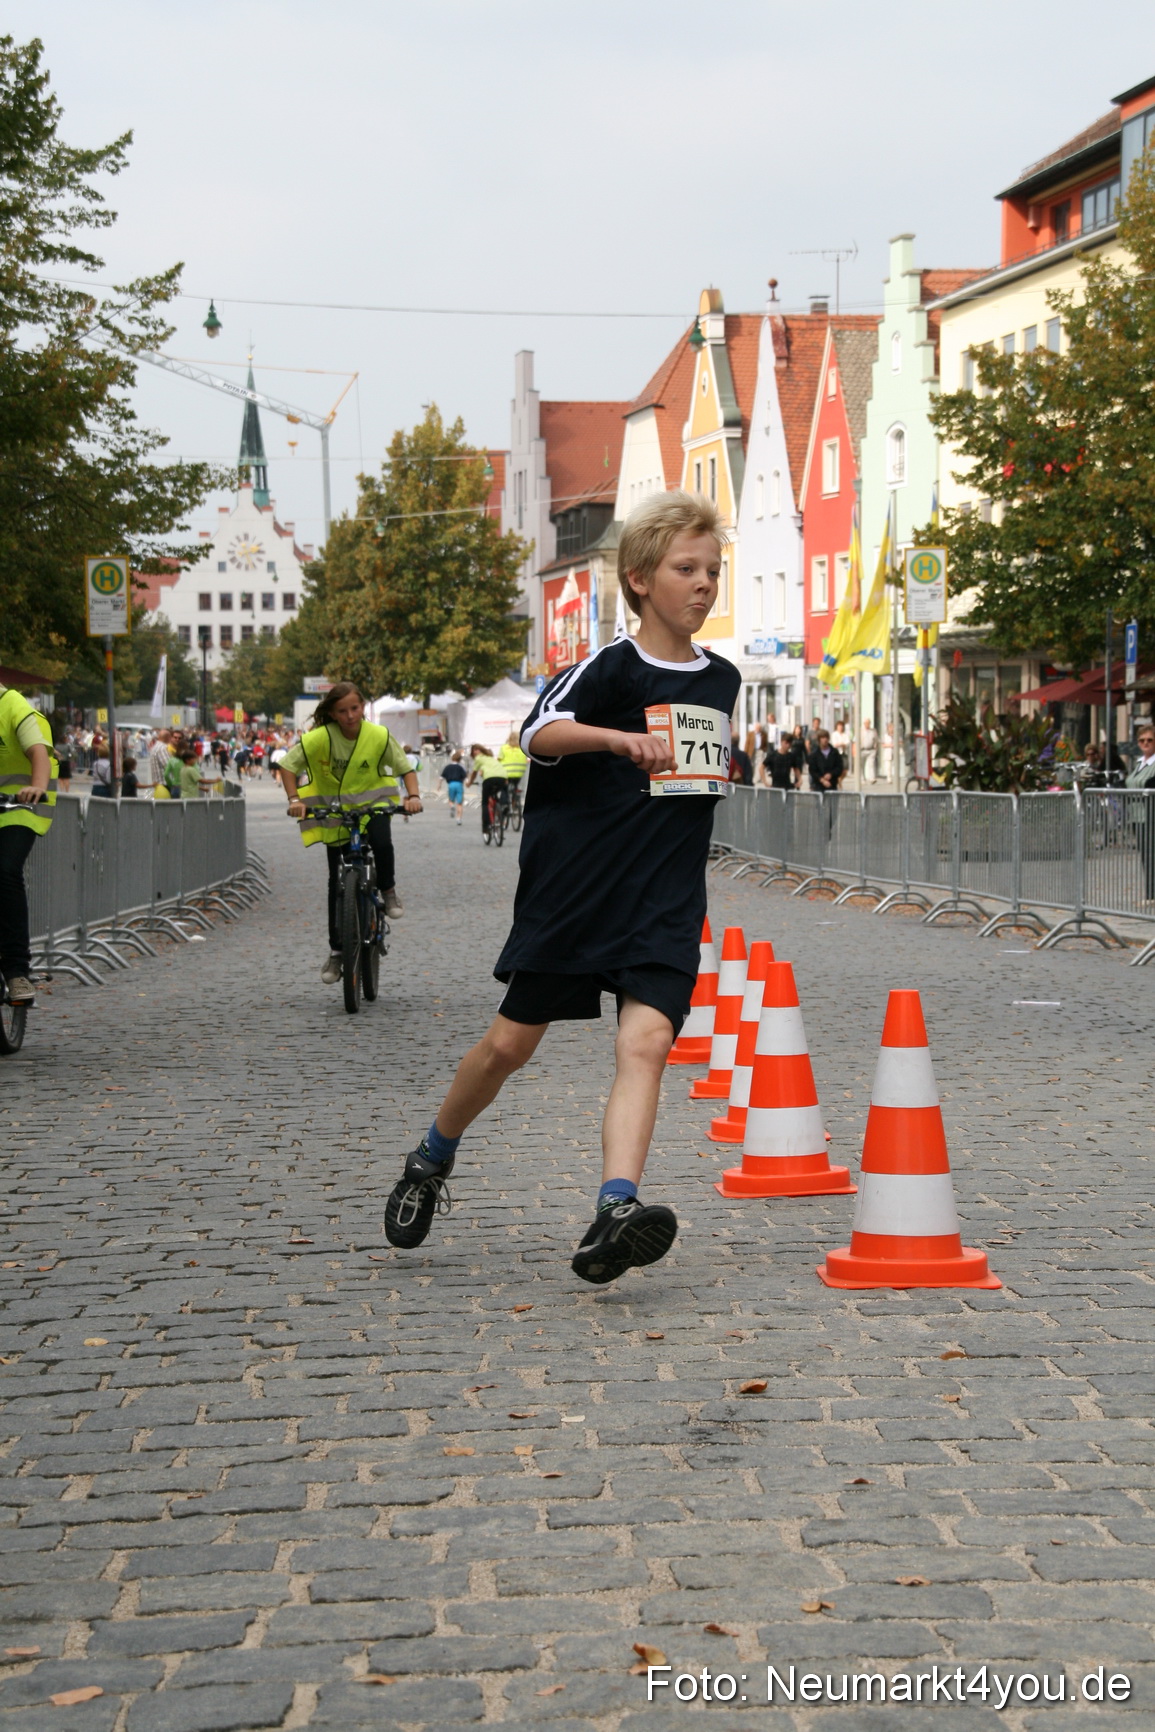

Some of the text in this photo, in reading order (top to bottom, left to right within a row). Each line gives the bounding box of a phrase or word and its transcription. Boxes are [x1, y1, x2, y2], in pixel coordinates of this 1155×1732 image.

[918, 560, 933, 577] H
[100, 569, 115, 587] H
[676, 712, 714, 731] Marco
[681, 740, 730, 771] 7179
